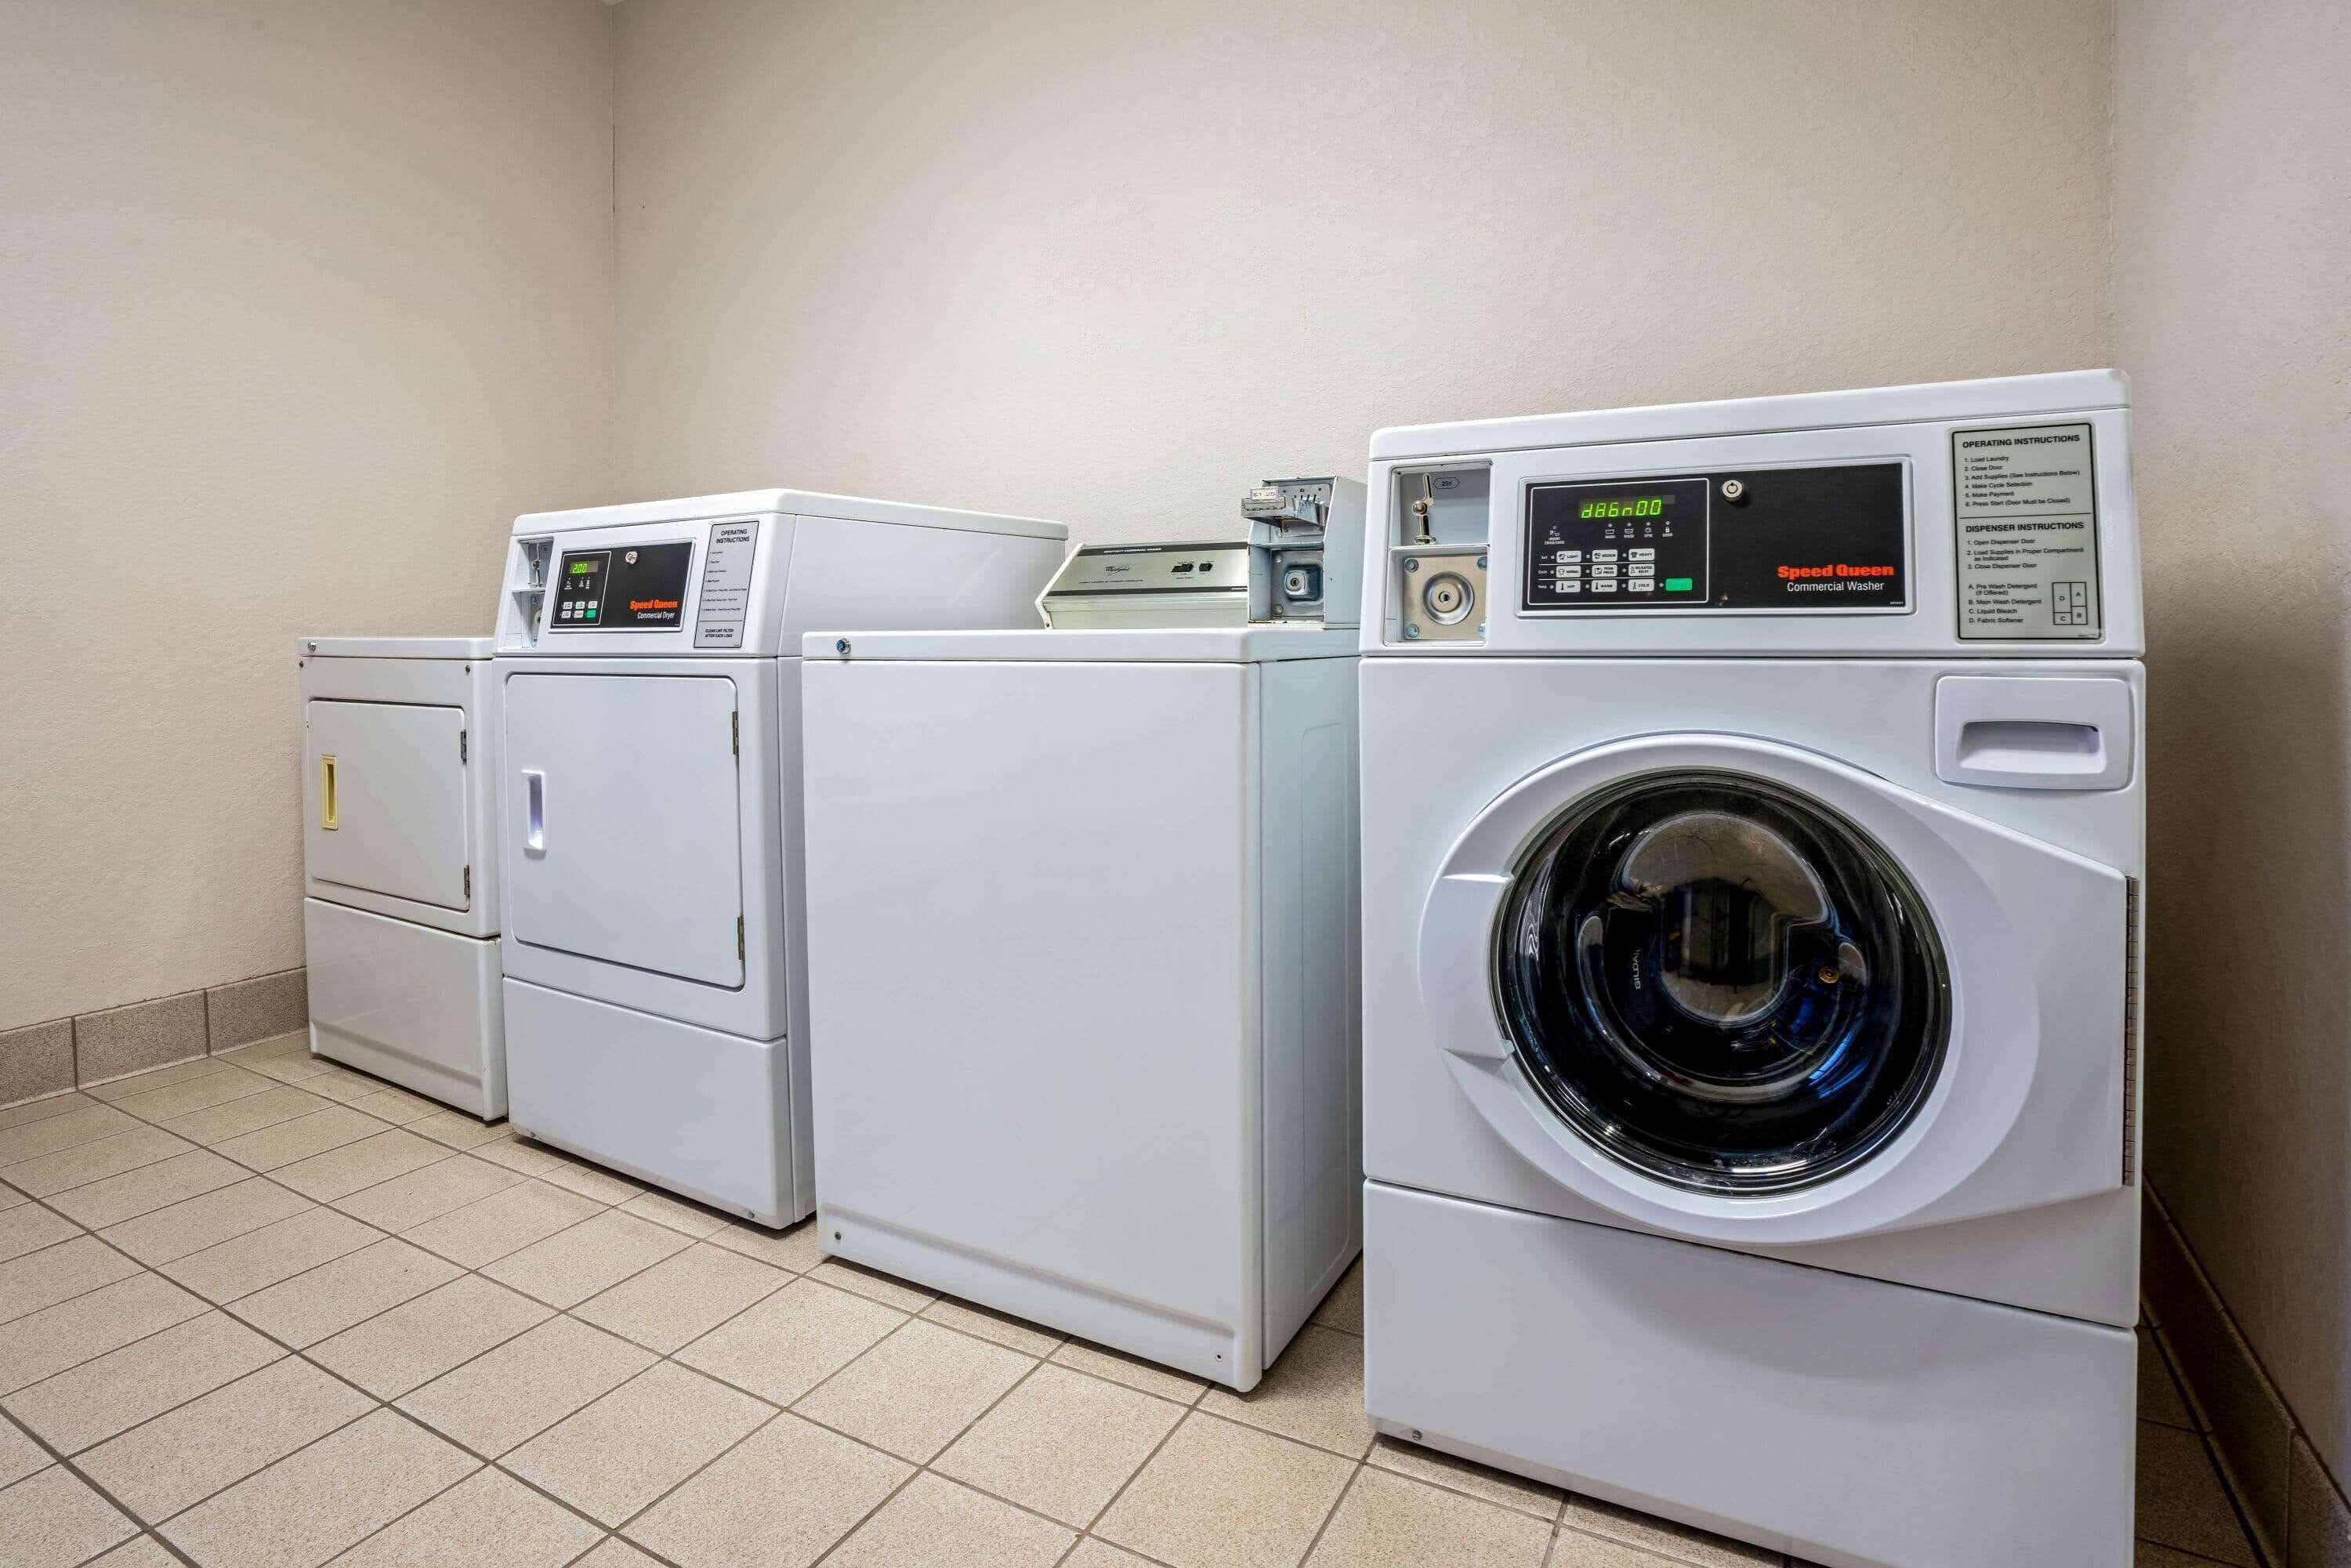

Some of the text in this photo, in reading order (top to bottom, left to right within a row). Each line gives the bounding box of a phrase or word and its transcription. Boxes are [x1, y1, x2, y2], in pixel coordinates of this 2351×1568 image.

[1962, 435, 2081, 448] OPERATING INSTRUCTIONS
[1965, 522, 2085, 533] DISPENSER INSTRUCTIONS
[1777, 564, 1894, 580] Speed Queen
[1787, 581, 1885, 592] Commercial Washer
[630, 599, 678, 610] Speed Queen
[663, 611, 675, 620] Dryer
